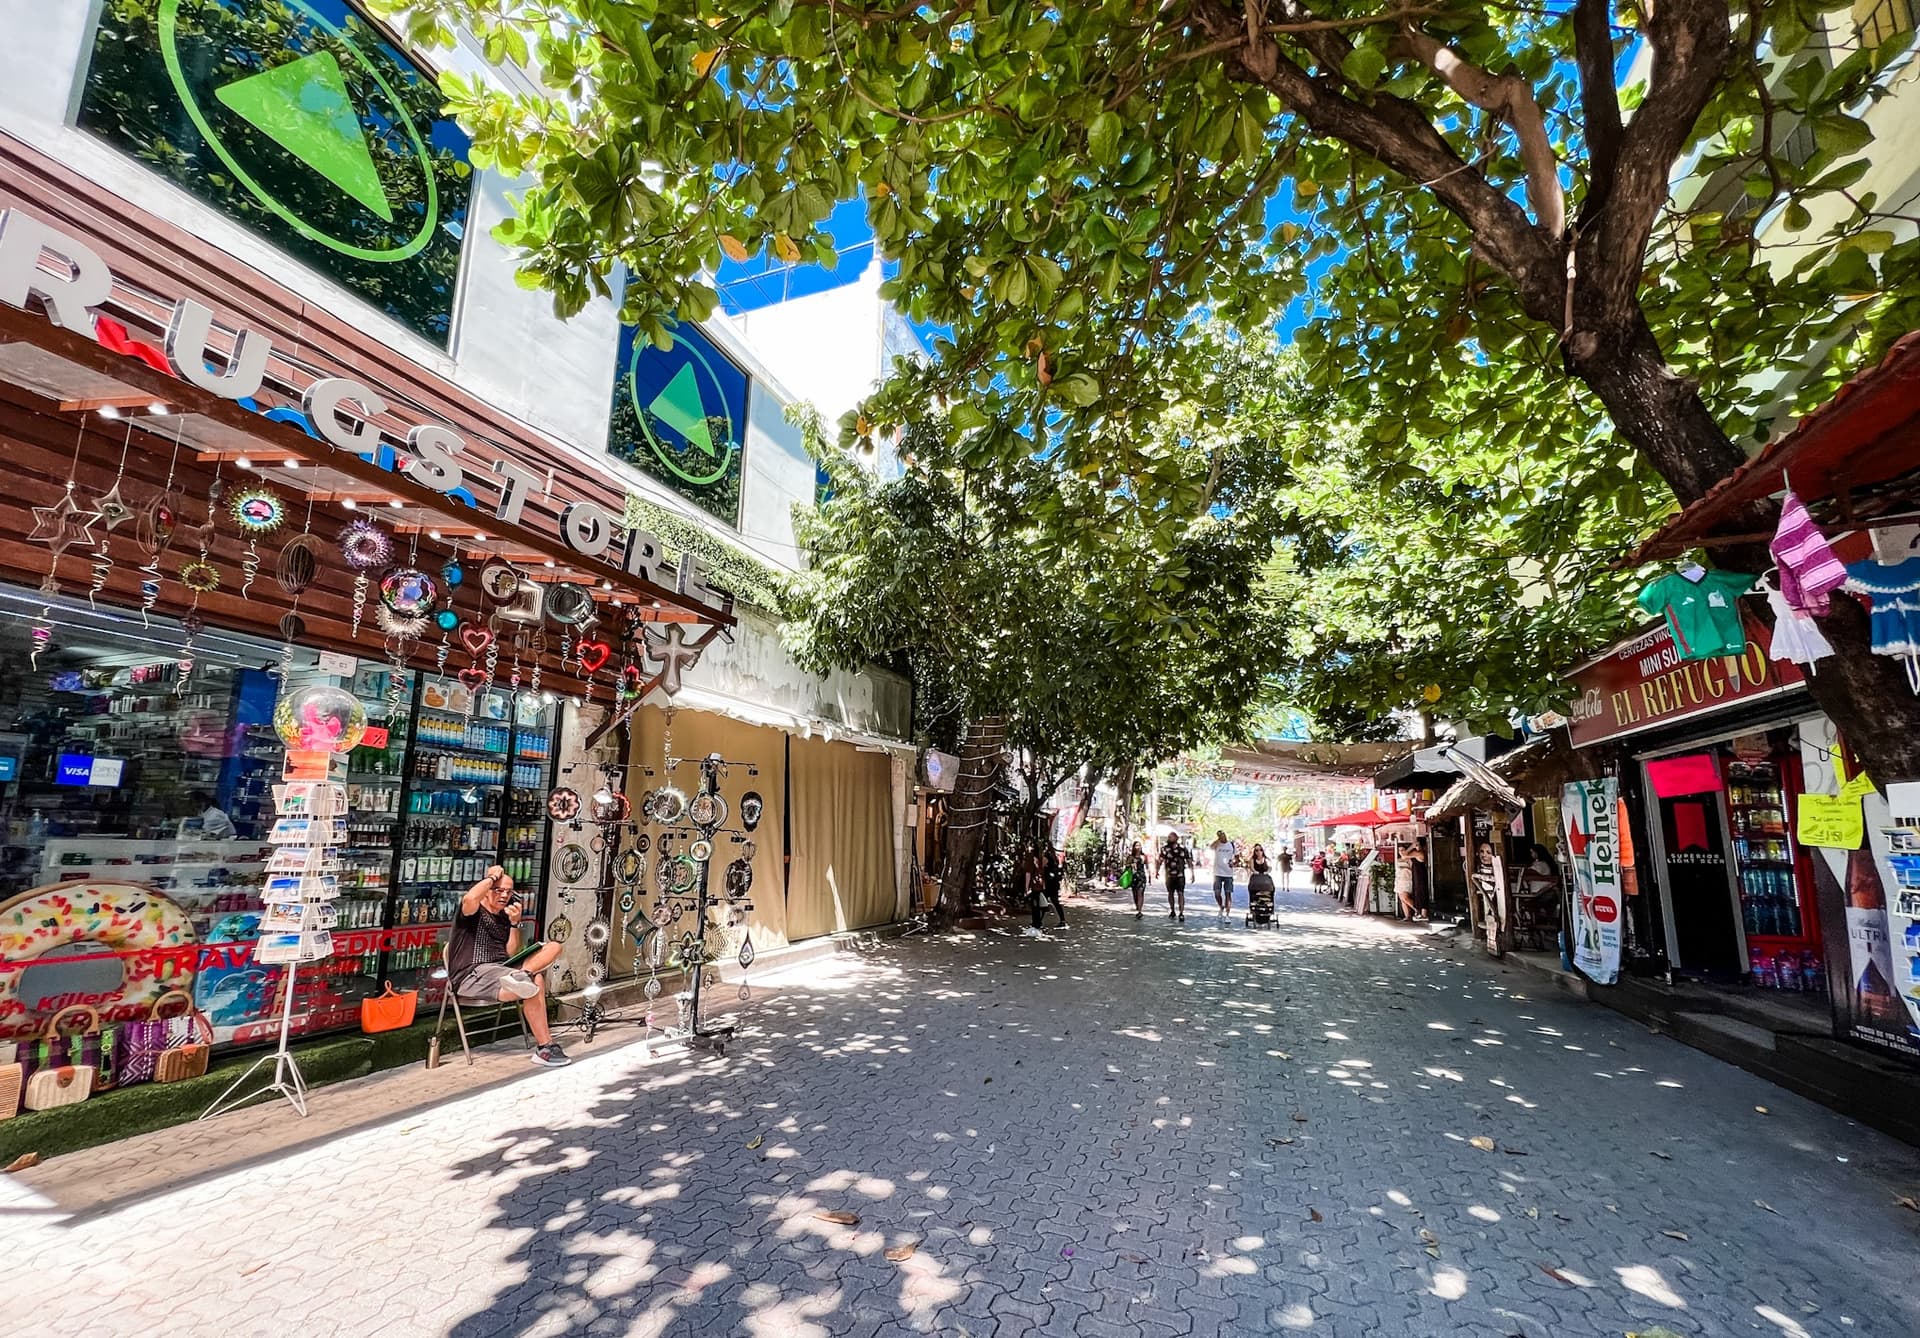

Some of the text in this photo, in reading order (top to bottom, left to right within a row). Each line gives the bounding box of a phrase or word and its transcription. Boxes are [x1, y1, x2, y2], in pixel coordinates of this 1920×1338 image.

[1618, 635, 1655, 661] CERVEZAS
[1639, 645, 1682, 677] MINI SU
[1610, 688, 1640, 727] EL
[63, 766, 90, 777] VISA
[331, 929, 438, 957] EDICINE
[1850, 927, 1889, 943] ULTRA
[36, 991, 124, 1011] Killers
